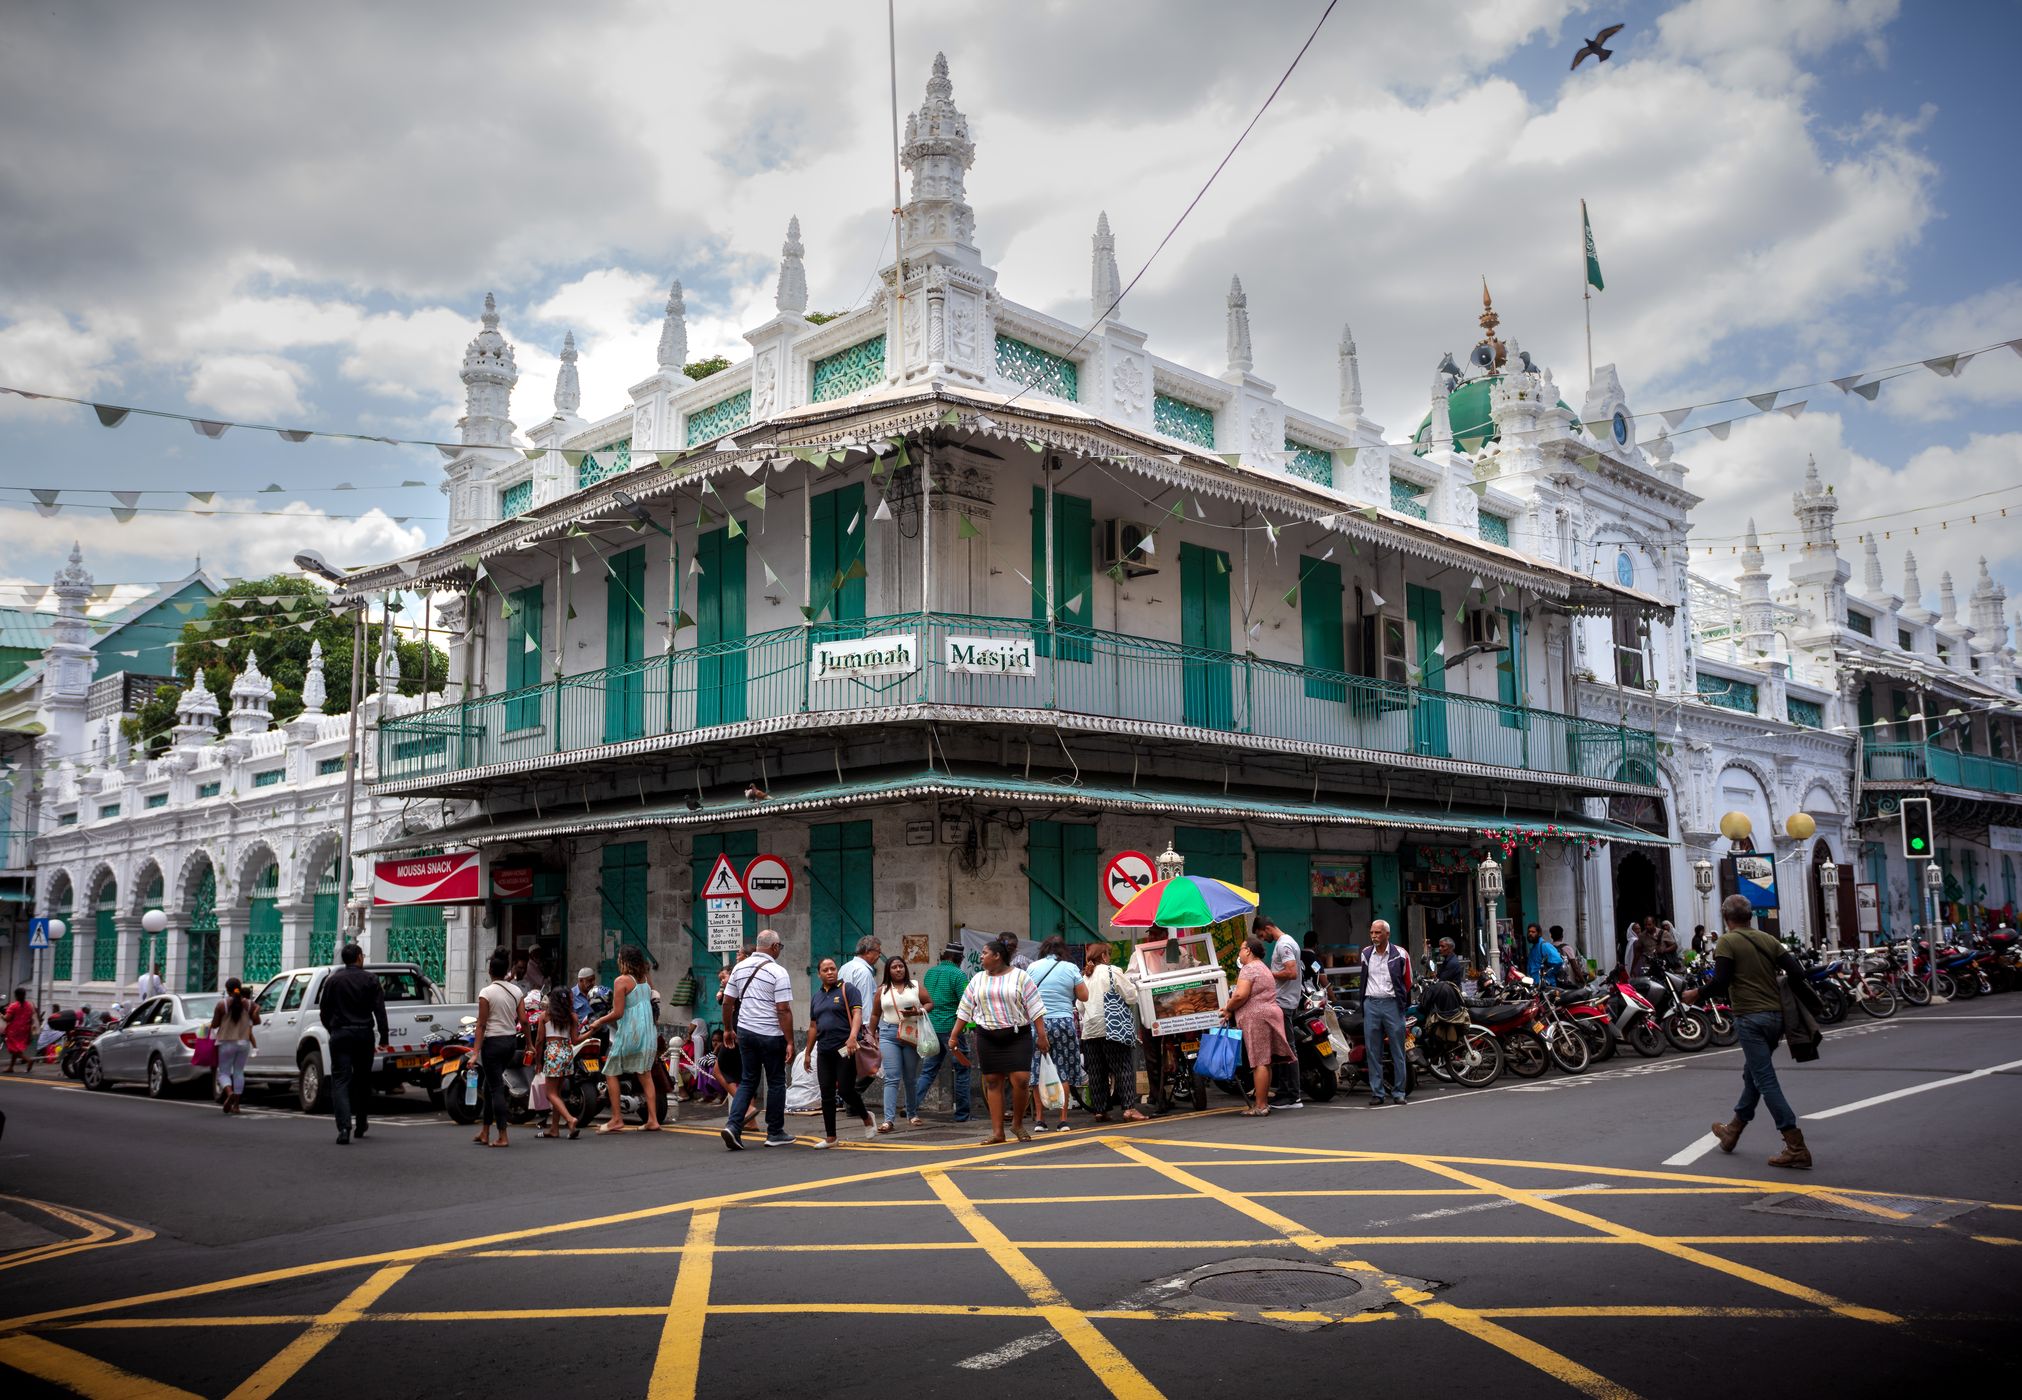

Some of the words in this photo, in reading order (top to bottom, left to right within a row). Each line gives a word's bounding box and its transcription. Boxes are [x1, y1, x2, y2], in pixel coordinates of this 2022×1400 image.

[818, 643, 911, 676] Jummah
[950, 643, 1032, 672] Masjid
[397, 863, 426, 878] MOUSSA
[427, 860, 452, 875] SNACK
